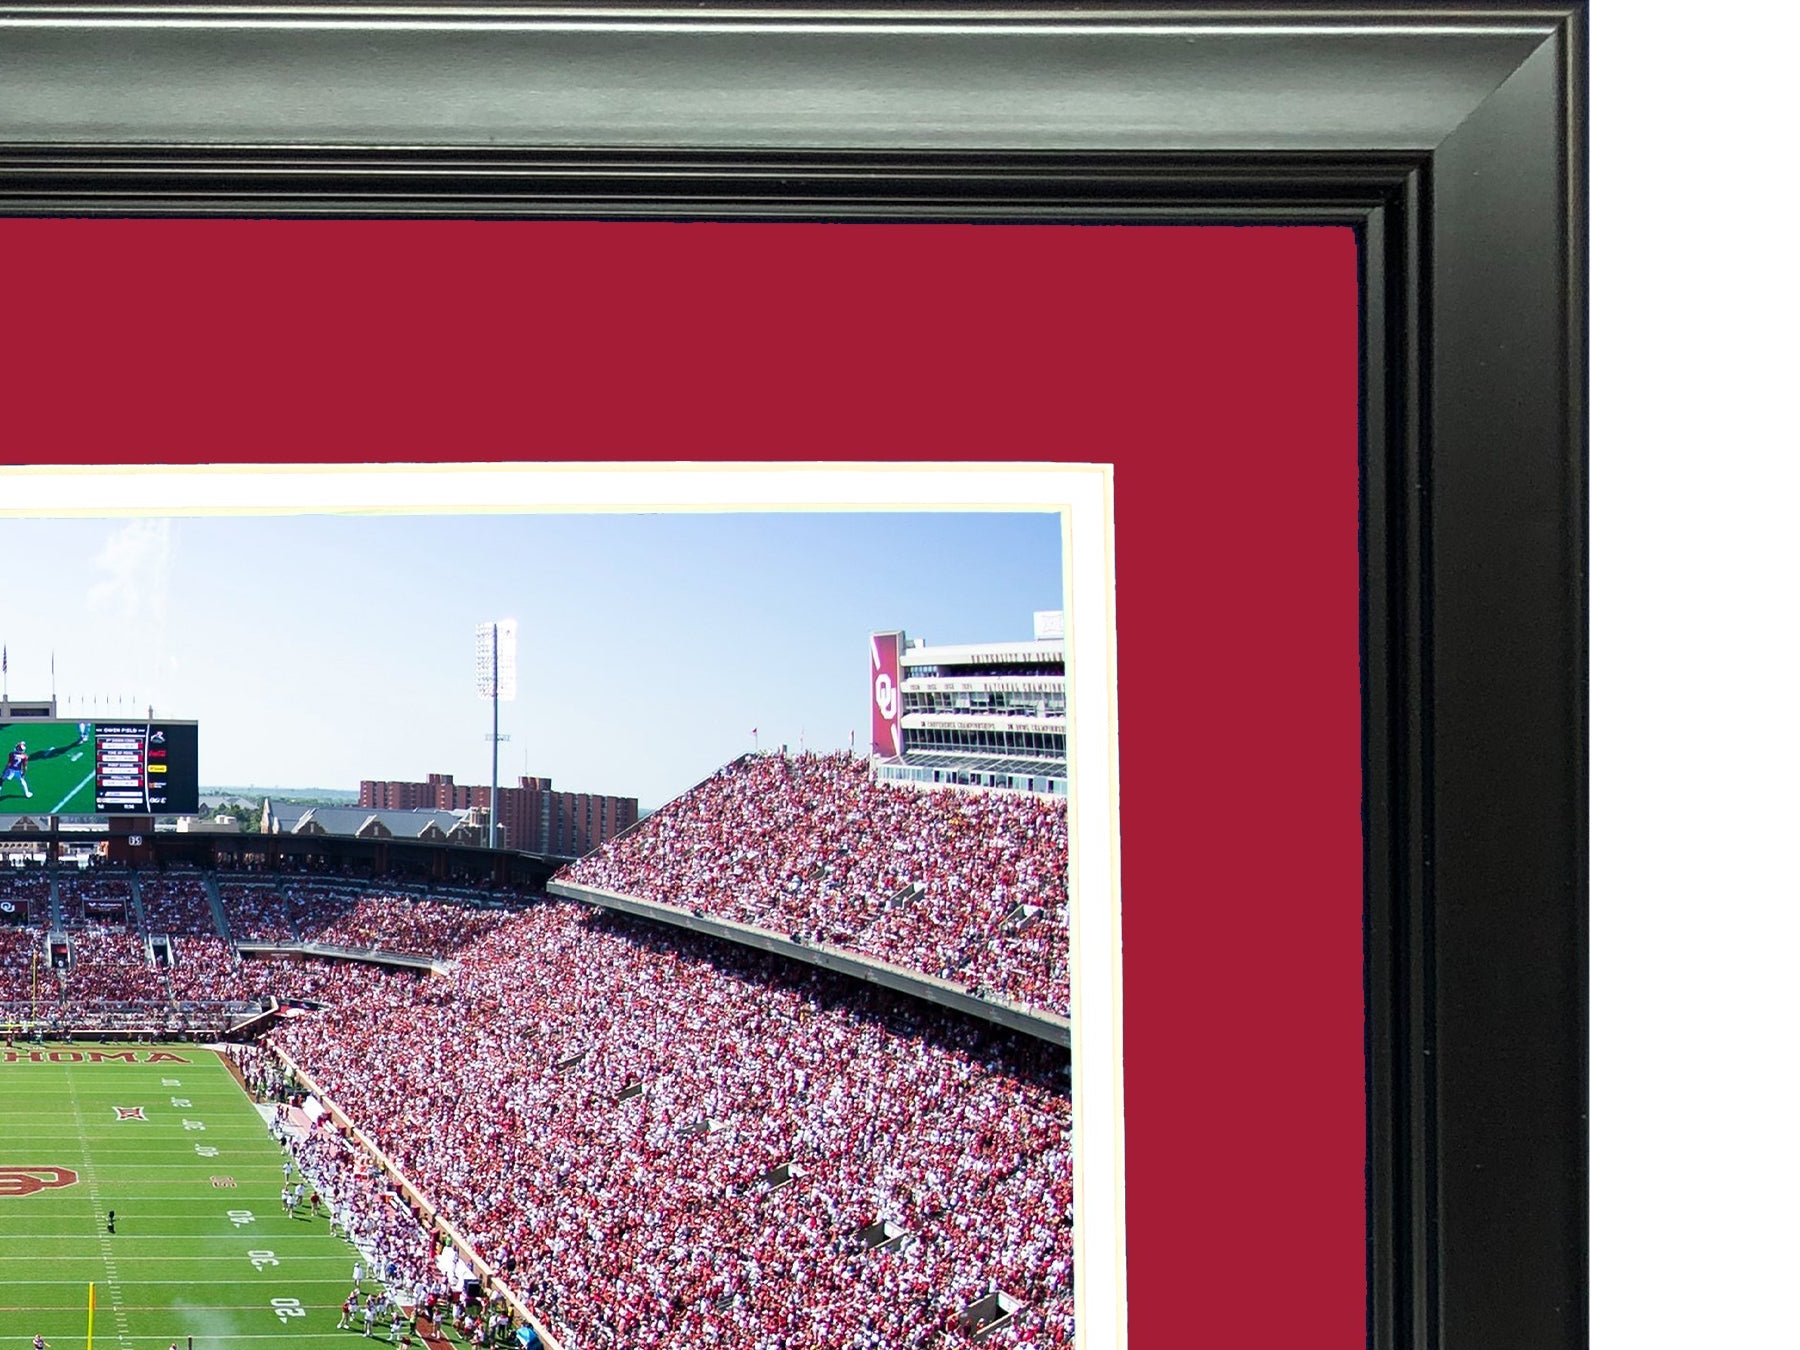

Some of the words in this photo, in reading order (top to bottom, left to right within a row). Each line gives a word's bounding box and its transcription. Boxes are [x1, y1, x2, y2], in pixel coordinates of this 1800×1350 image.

[875, 673, 897, 720] OU
[248, 1250, 279, 1266] 30
[271, 1298, 306, 1317] 20
